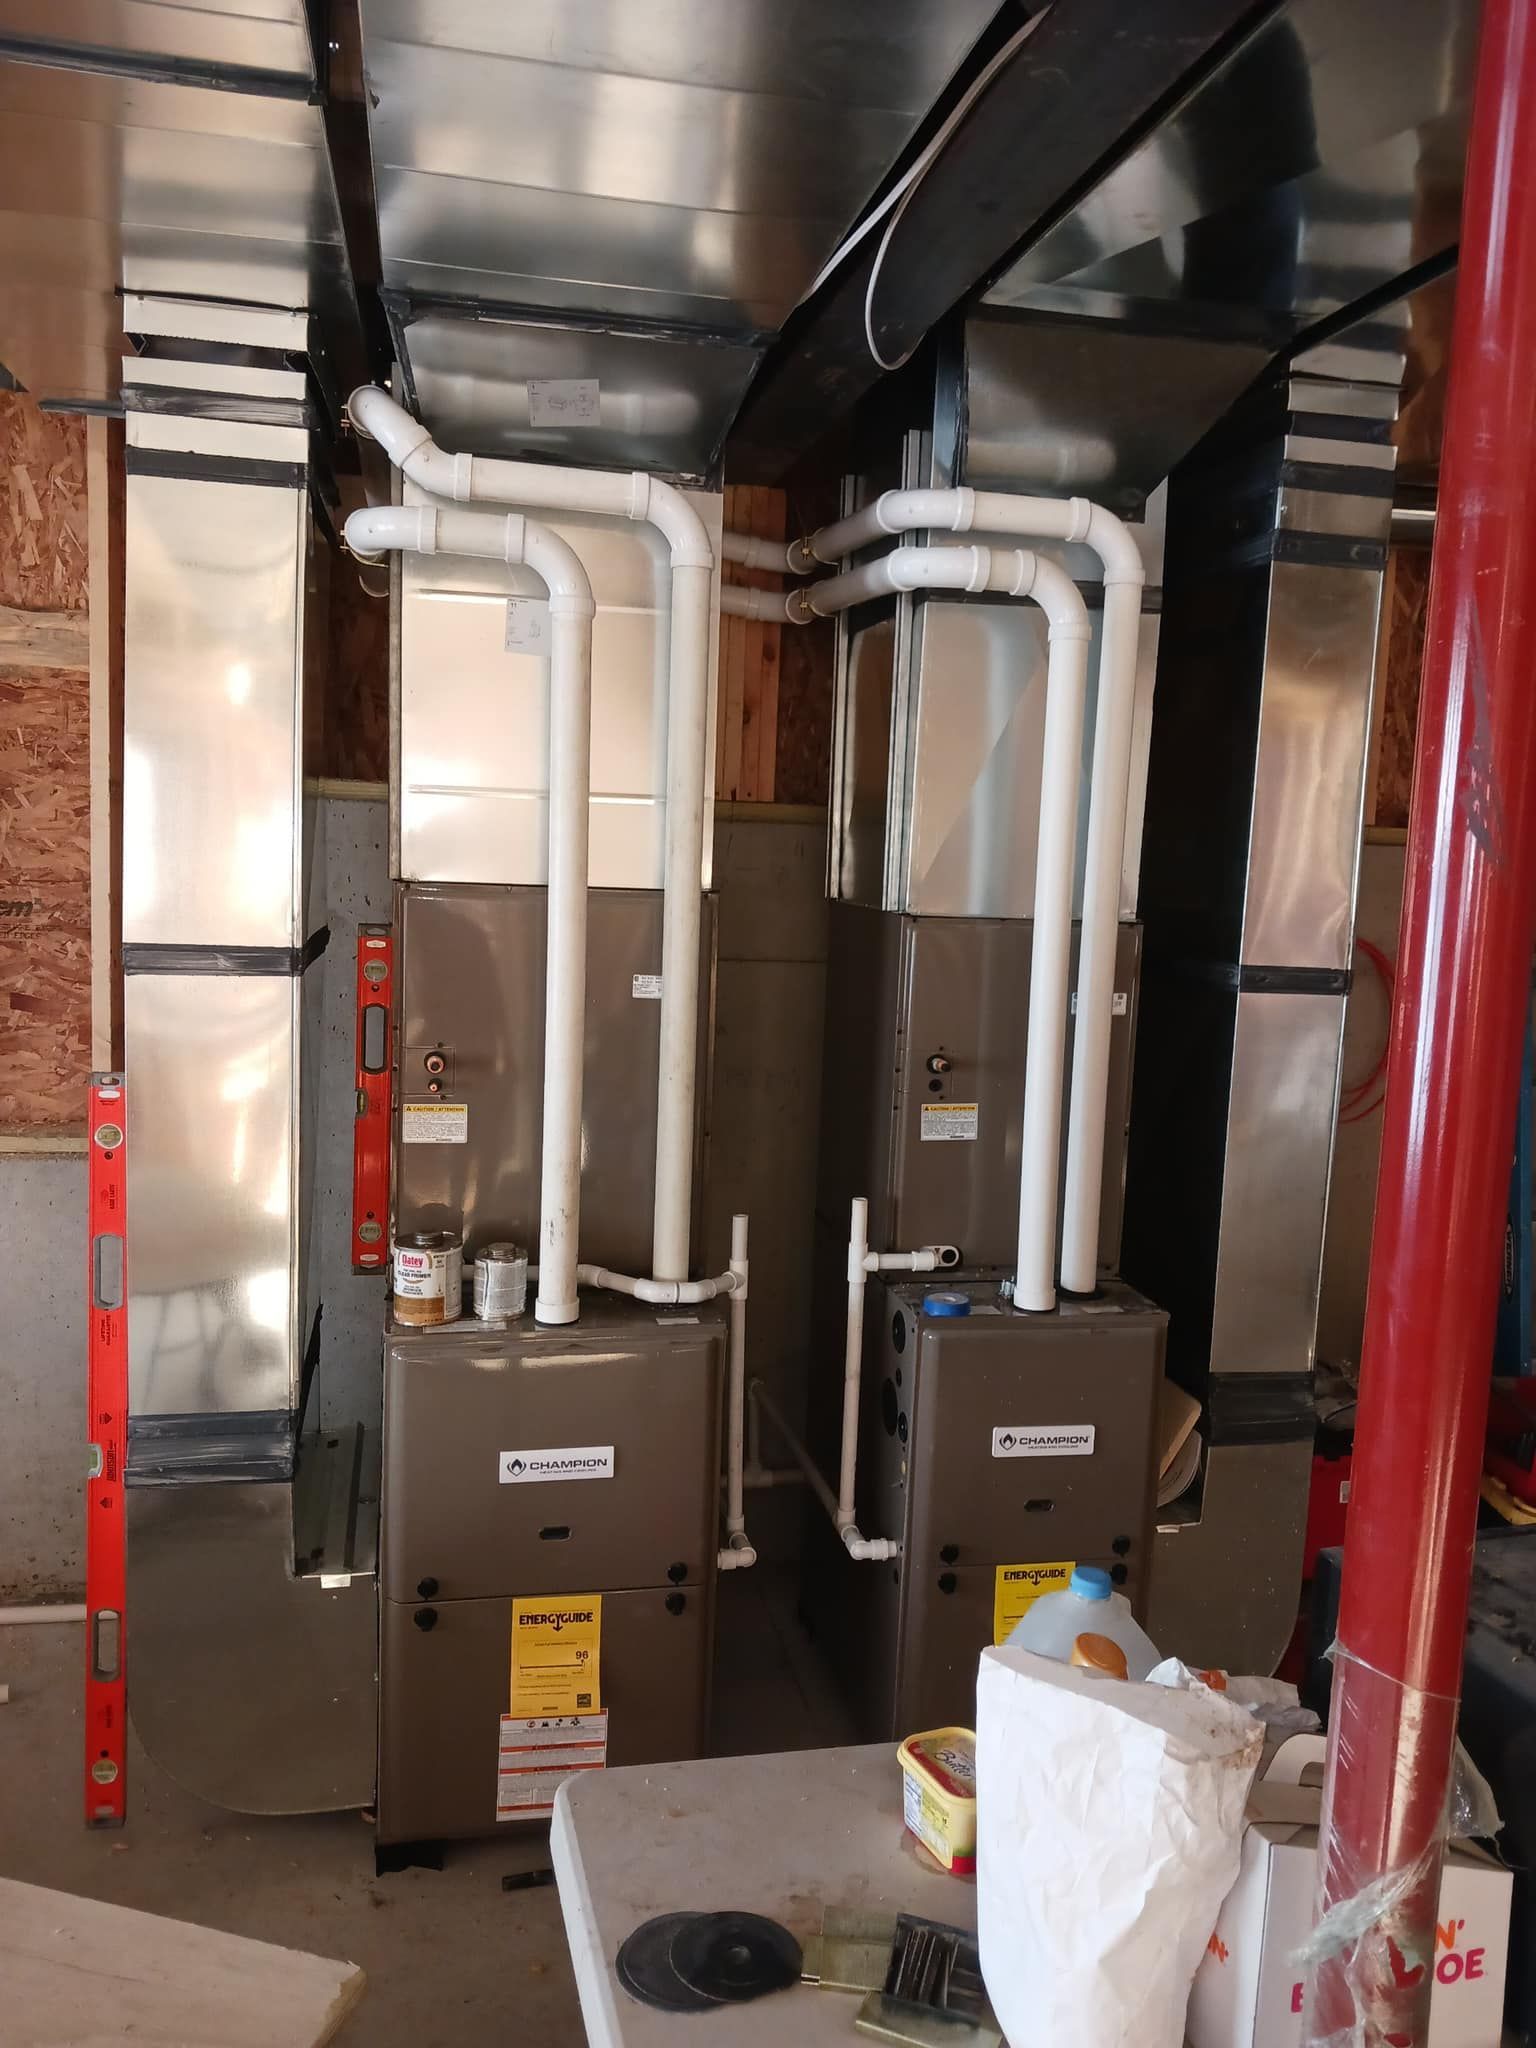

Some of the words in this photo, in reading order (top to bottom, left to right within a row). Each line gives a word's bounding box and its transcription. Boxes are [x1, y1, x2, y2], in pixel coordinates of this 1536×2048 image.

[402, 1254, 424, 1268] Oatey
[1019, 1435, 1089, 1445] CHAMPION
[529, 1458, 608, 1471] CHAMPION
[1003, 1569, 1066, 1581] ENERGYGUIDE
[519, 1612, 593, 1626] ENERGYGUIDE
[575, 1651, 589, 1660] 96
